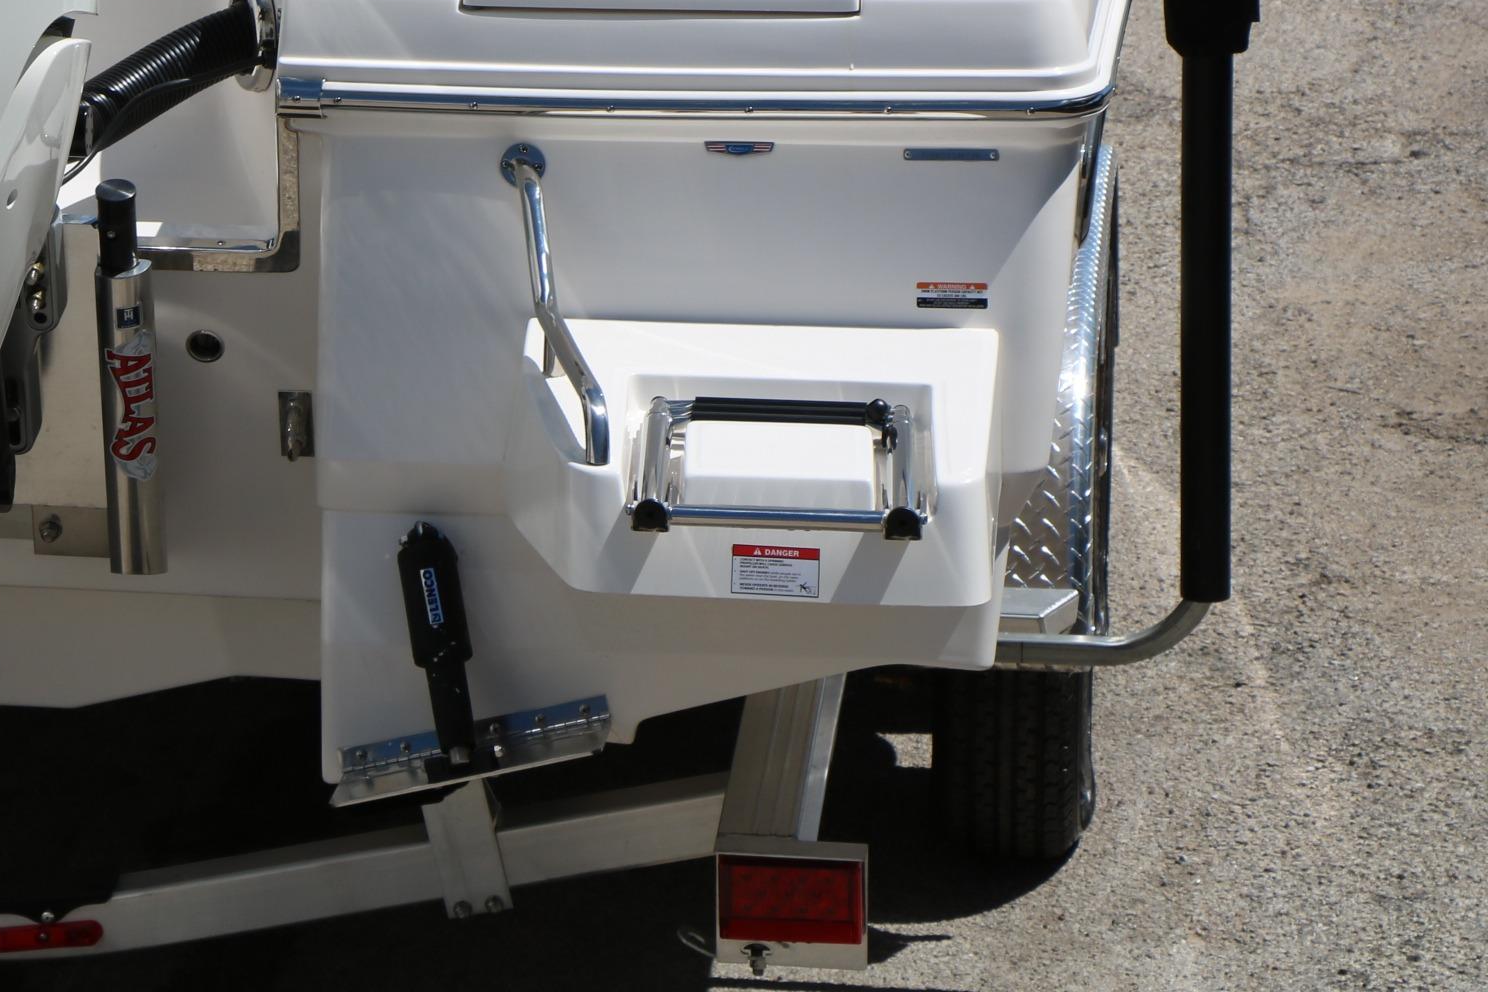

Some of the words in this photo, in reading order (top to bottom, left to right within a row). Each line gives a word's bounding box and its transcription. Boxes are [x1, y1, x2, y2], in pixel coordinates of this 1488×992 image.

[106, 349, 157, 462] ATLAS
[764, 549, 800, 557] DANGER
[423, 569, 442, 613] LENCO
